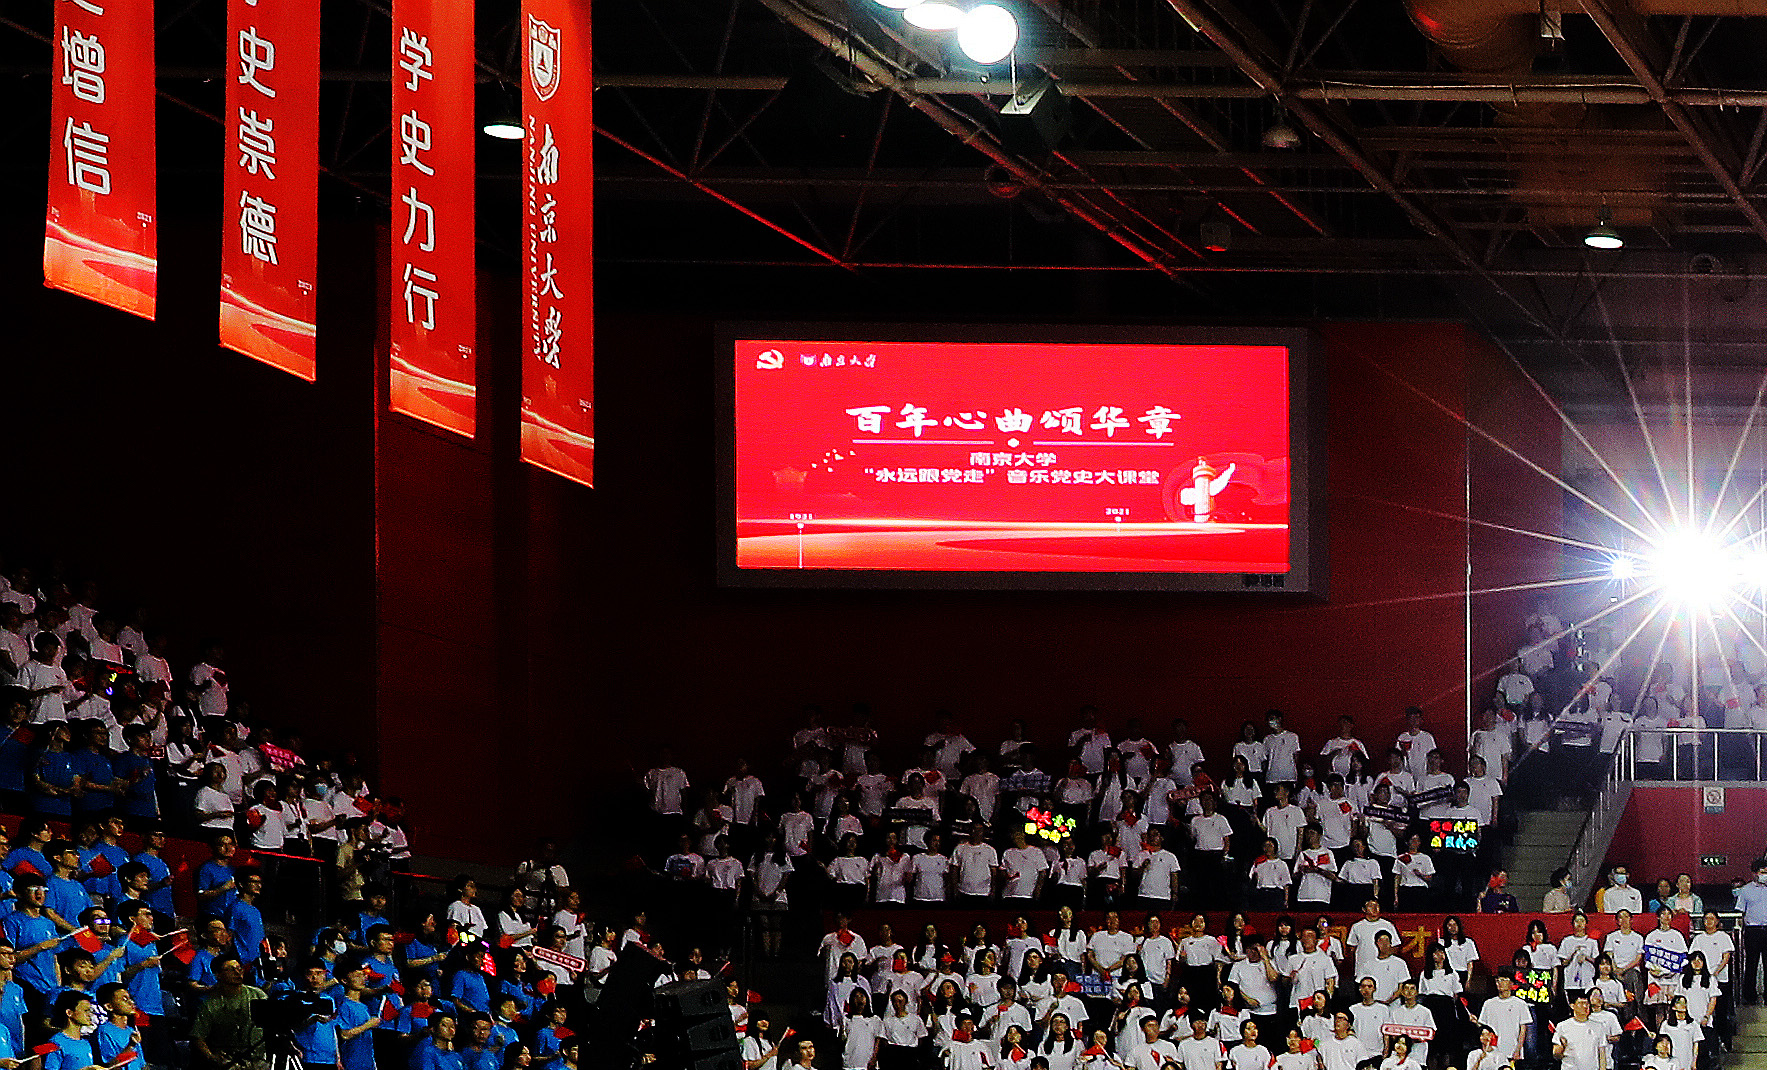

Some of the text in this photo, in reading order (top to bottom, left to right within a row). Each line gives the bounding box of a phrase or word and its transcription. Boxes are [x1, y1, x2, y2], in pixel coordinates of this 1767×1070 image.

[61, 0, 111, 195] 增信
[238, 0, 279, 265] 史崇德
[399, 27, 440, 330] 学史力行
[846, 403, 1181, 439] 百年心曲颂华章
[969, 451, 1057, 467] 南京大学
[1007, 469, 1160, 485] 音乐党史大课堂
